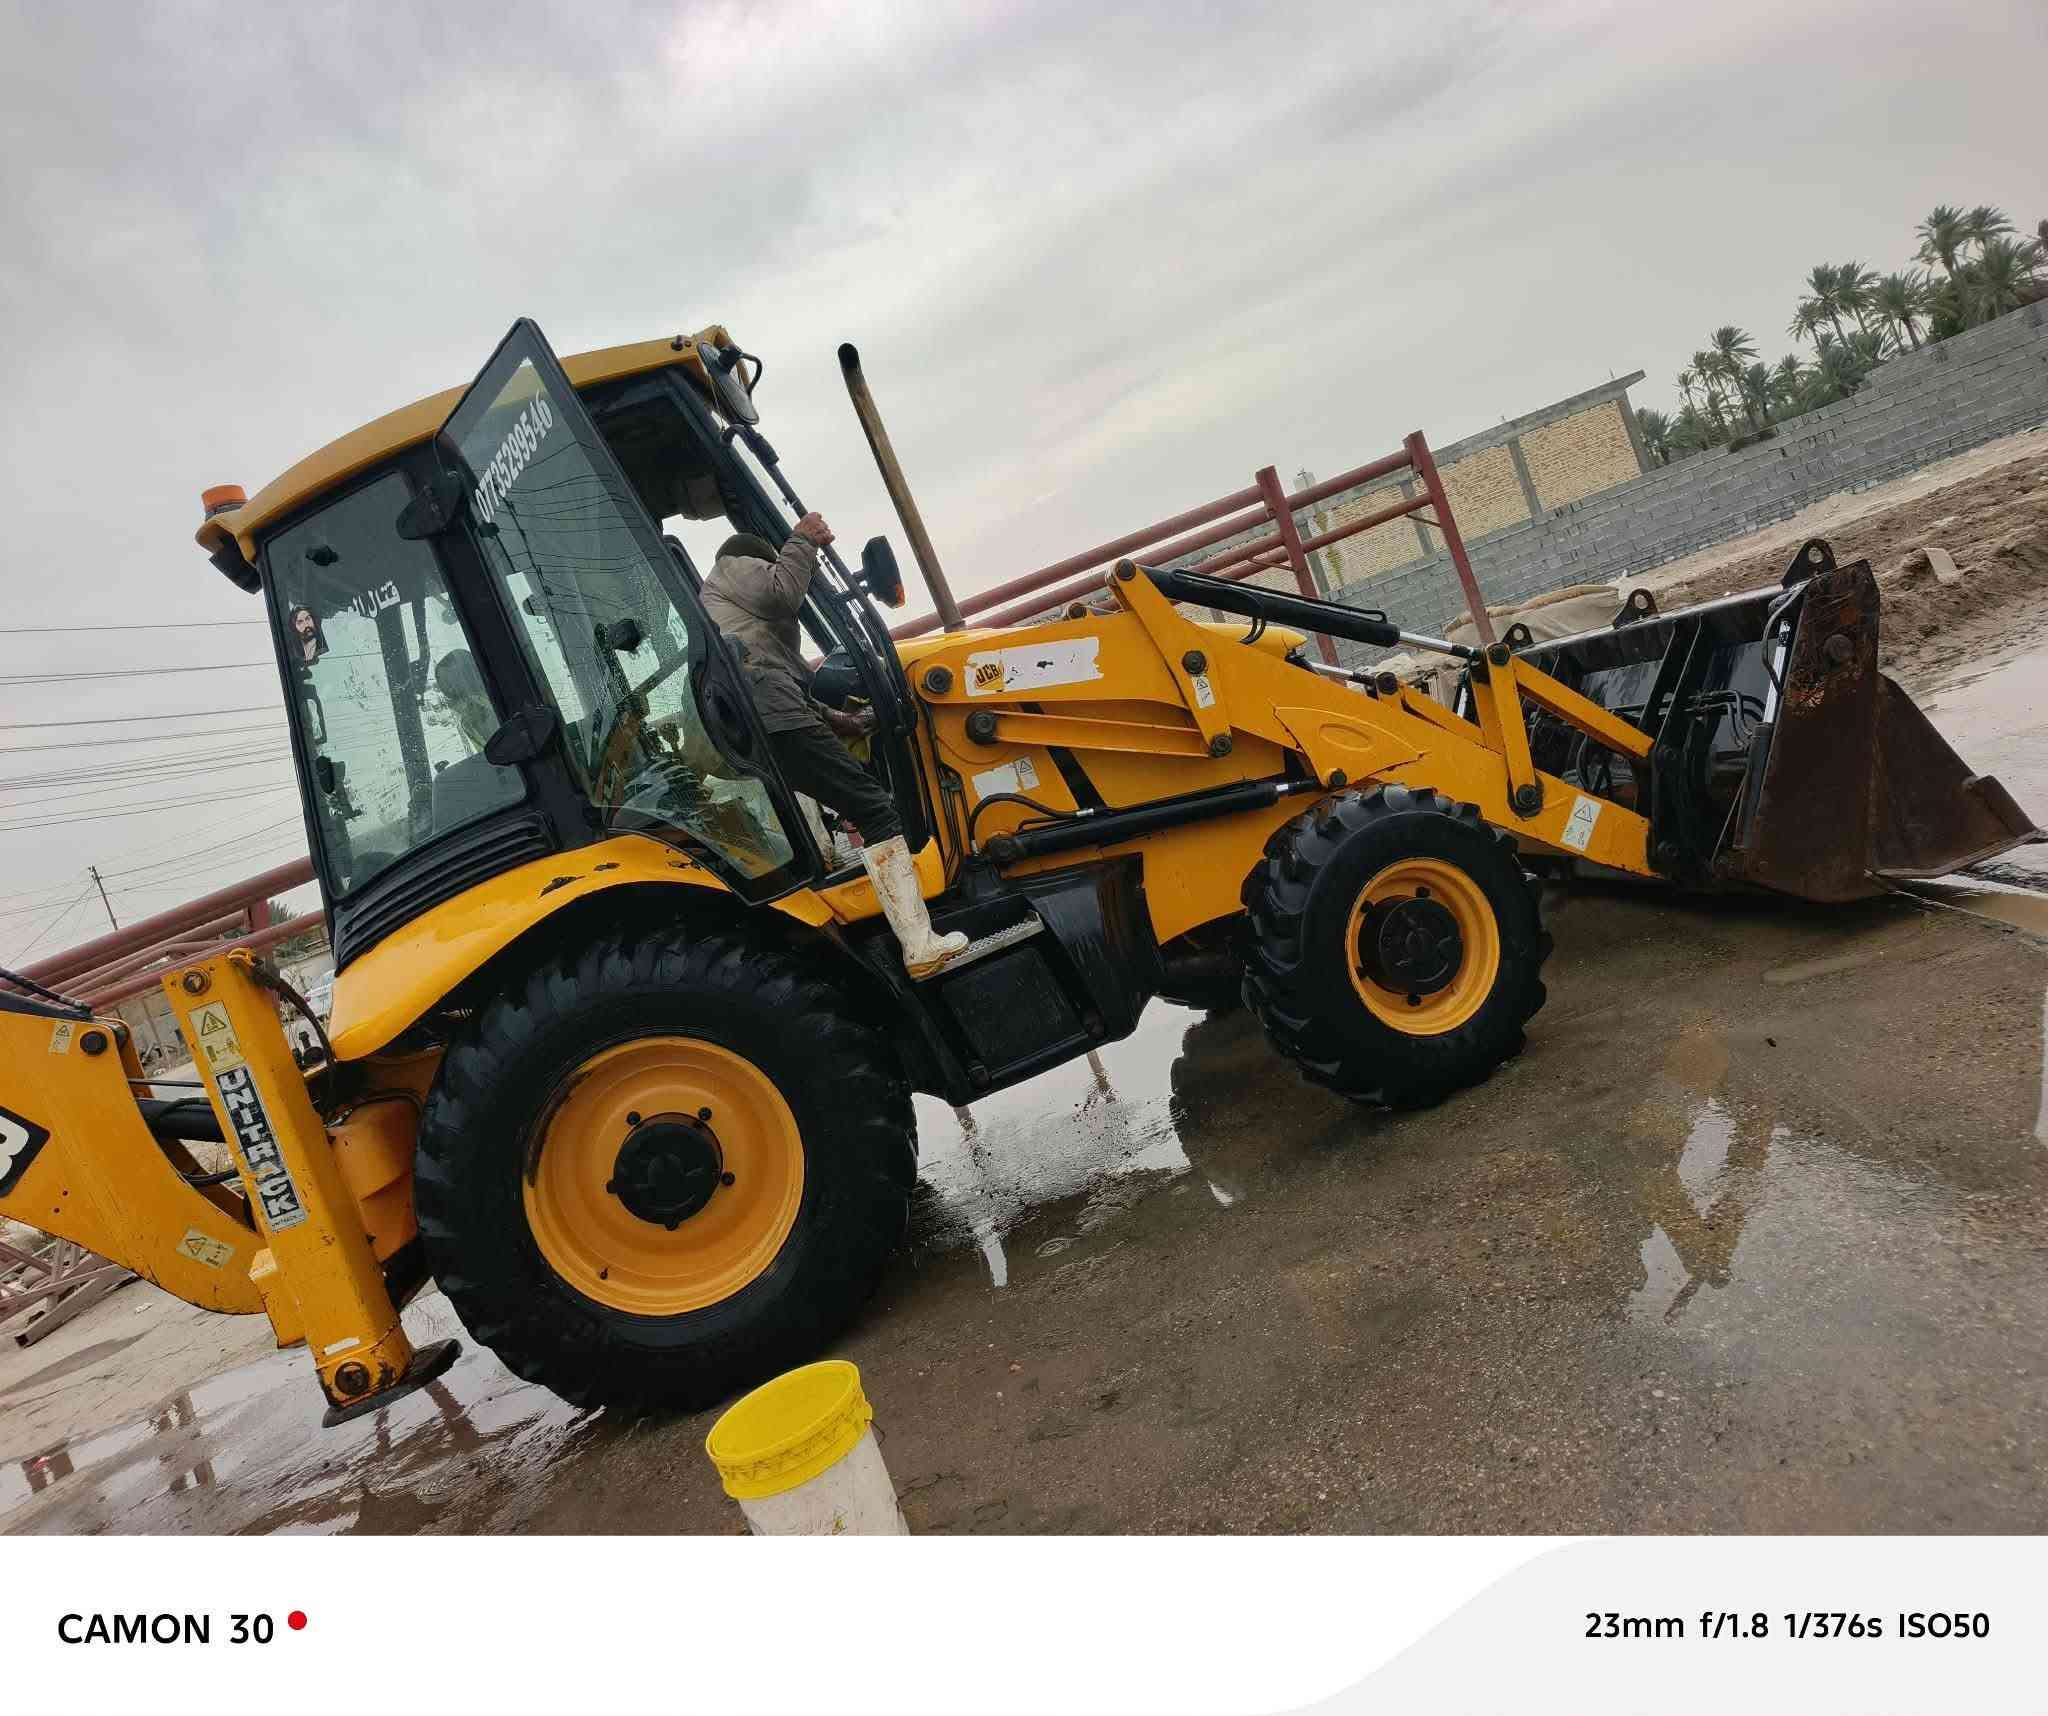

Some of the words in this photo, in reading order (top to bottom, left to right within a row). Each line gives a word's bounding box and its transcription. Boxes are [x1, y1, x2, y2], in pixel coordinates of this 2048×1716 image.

[475, 388, 552, 523] 07735299546
[976, 663, 1000, 684] JCB
[218, 1067, 299, 1217] UNITRACK
